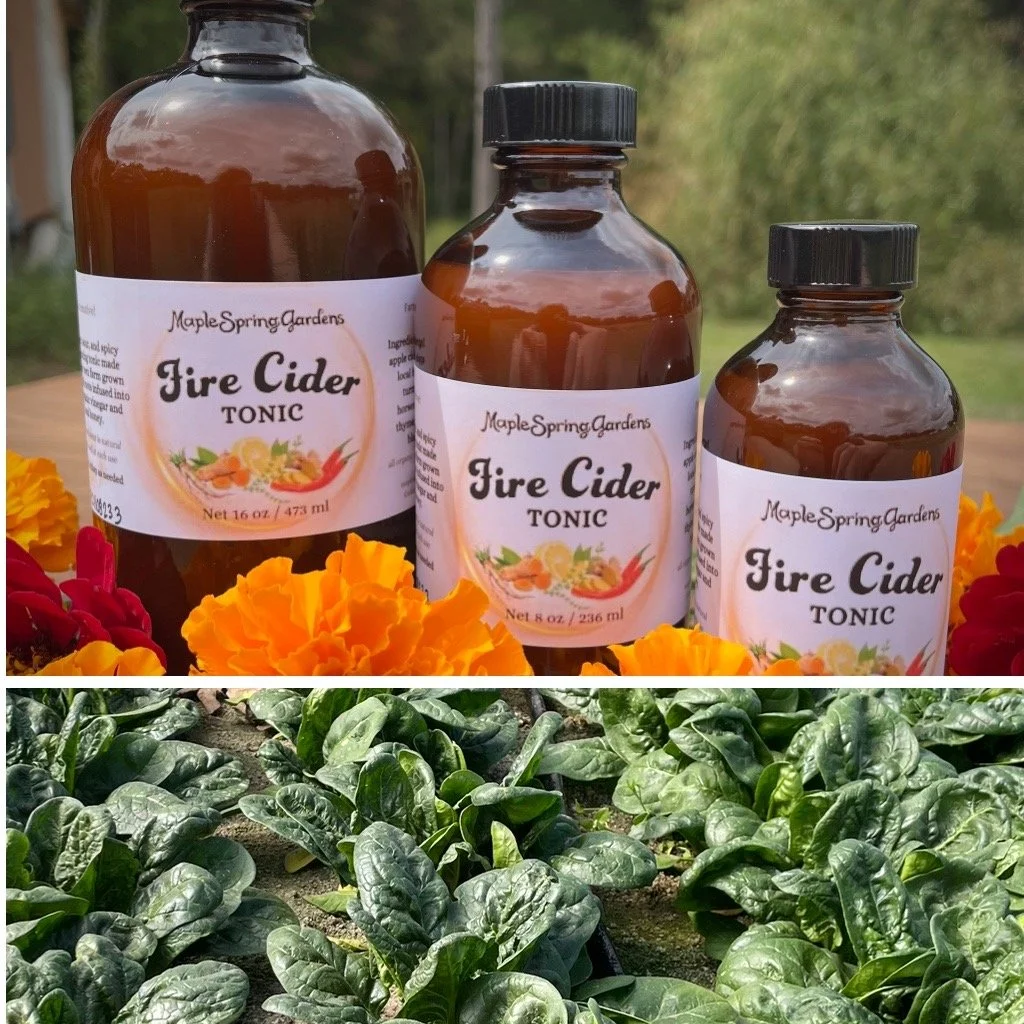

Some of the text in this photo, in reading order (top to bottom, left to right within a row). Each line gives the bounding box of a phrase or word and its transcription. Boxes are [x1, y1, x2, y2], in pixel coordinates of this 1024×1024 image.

[168, 308, 345, 334] Maple Spring Gardens
[101, 343, 119, 357] spicy
[102, 374, 125, 386] grown
[157, 351, 361, 402] Fire Cider
[114, 389, 130, 401] into
[110, 404, 123, 415] and
[221, 403, 304, 424] TONIC
[480, 410, 651, 438] Maple Spring Gardens
[468, 457, 549, 501] Fire
[561, 456, 661, 500] Cider
[203, 508, 227, 520] Net
[233, 509, 248, 521] 16
[253, 509, 270, 519] oz
[285, 505, 307, 517] 473
[312, 499, 329, 514] ml
[527, 508, 608, 528] TONIC
[761, 499, 940, 533] Maple Spring Gardens
[745, 548, 943, 595] Fire Cider
[505, 608, 530, 622] Net
[535, 612, 543, 623] 8
[547, 612, 564, 623] oz
[579, 612, 602, 623] 236
[607, 607, 624, 622] ml
[810, 605, 895, 625] TONIC
